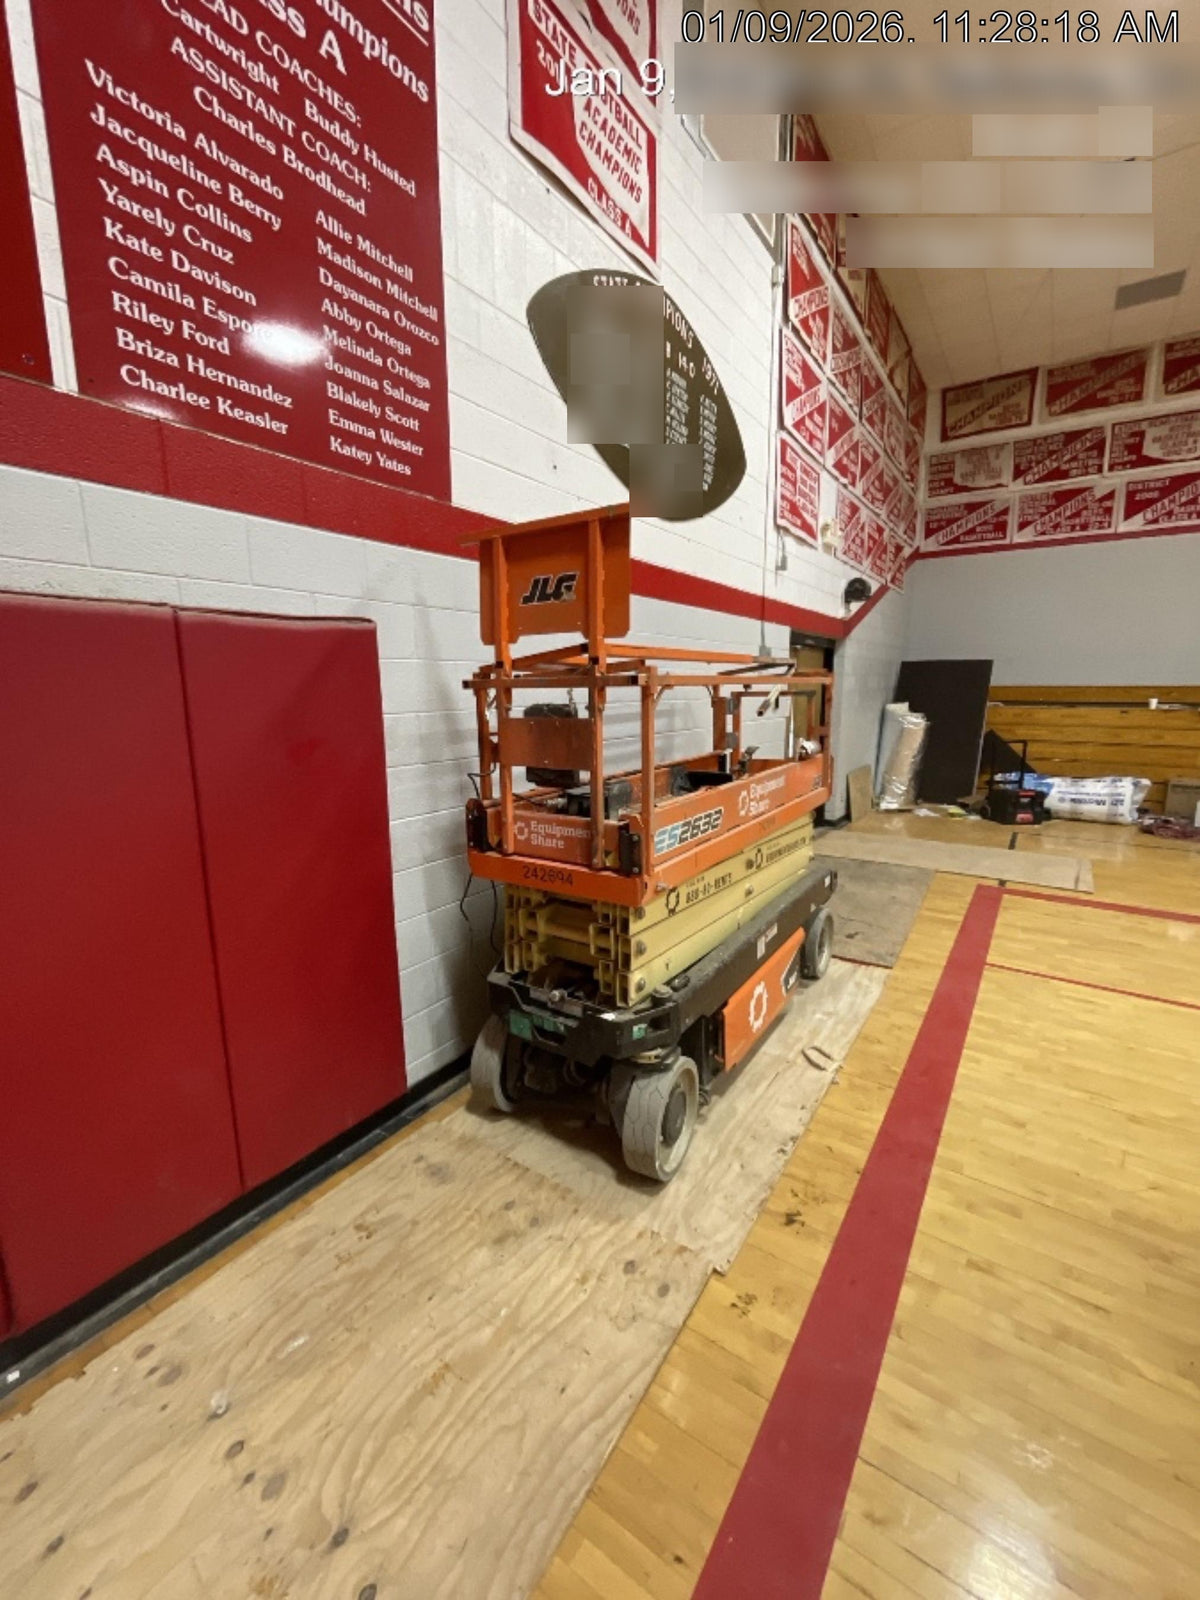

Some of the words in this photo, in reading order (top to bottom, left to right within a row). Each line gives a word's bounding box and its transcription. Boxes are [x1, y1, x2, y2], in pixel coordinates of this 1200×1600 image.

[318, 29, 347, 76] A
[532, 1, 578, 68] STATE
[161, 0, 279, 95] Cartwright
[304, 97, 359, 155] Buddy
[170, 36, 297, 138] ASSISTANT
[301, 131, 371, 192] COACH:
[255, 30, 361, 128] COACHES:
[84, 58, 187, 142] Victoria
[194, 132, 284, 200] Alvarado
[193, 86, 277, 156] Charles
[282, 144, 367, 217] Brodhead
[579, 120, 643, 203] CHAMPIONS
[583, 96, 642, 175] ACADEMIC
[90, 102, 222, 195] Jacqueline
[228, 182, 282, 232] Berry
[96, 144, 169, 199] Aspin
[177, 187, 253, 243] Collins
[97, 177, 176, 237] Yarely
[182, 223, 235, 266] Cruz
[315, 209, 353, 244] Allie
[356, 233, 414, 284] Mitchell
[102, 216, 164, 262] Kate
[170, 248, 257, 307] Davison
[108, 256, 197, 310] Camila
[315, 236, 384, 291] Madison
[385, 278, 439, 323] Mitchell
[111, 290, 175, 335] Riley
[181, 319, 231, 357] Ford
[319, 266, 390, 320] Dayanara
[393, 310, 440, 346] Orozco
[321, 298, 361, 333] Abby
[365, 321, 412, 357] Ortega
[663, 296, 695, 349] PIONS
[115, 326, 180, 368] Briza
[186, 353, 293, 409] Hernandez
[323, 324, 383, 367] Melinda
[386, 356, 431, 390] Ortega
[324, 355, 379, 390] Joanna
[383, 379, 431, 412] Salazar
[119, 364, 211, 410] Charlee
[216, 396, 289, 435] Keasler
[326, 380, 381, 418] Blakely
[384, 406, 420, 433] Scott
[328, 408, 376, 440] Emma
[379, 427, 424, 456] Wester
[329, 435, 373, 466] Katey
[375, 451, 412, 476] Yates
[530, 833, 565, 849] Share
[531, 821, 592, 838] Equipmen
